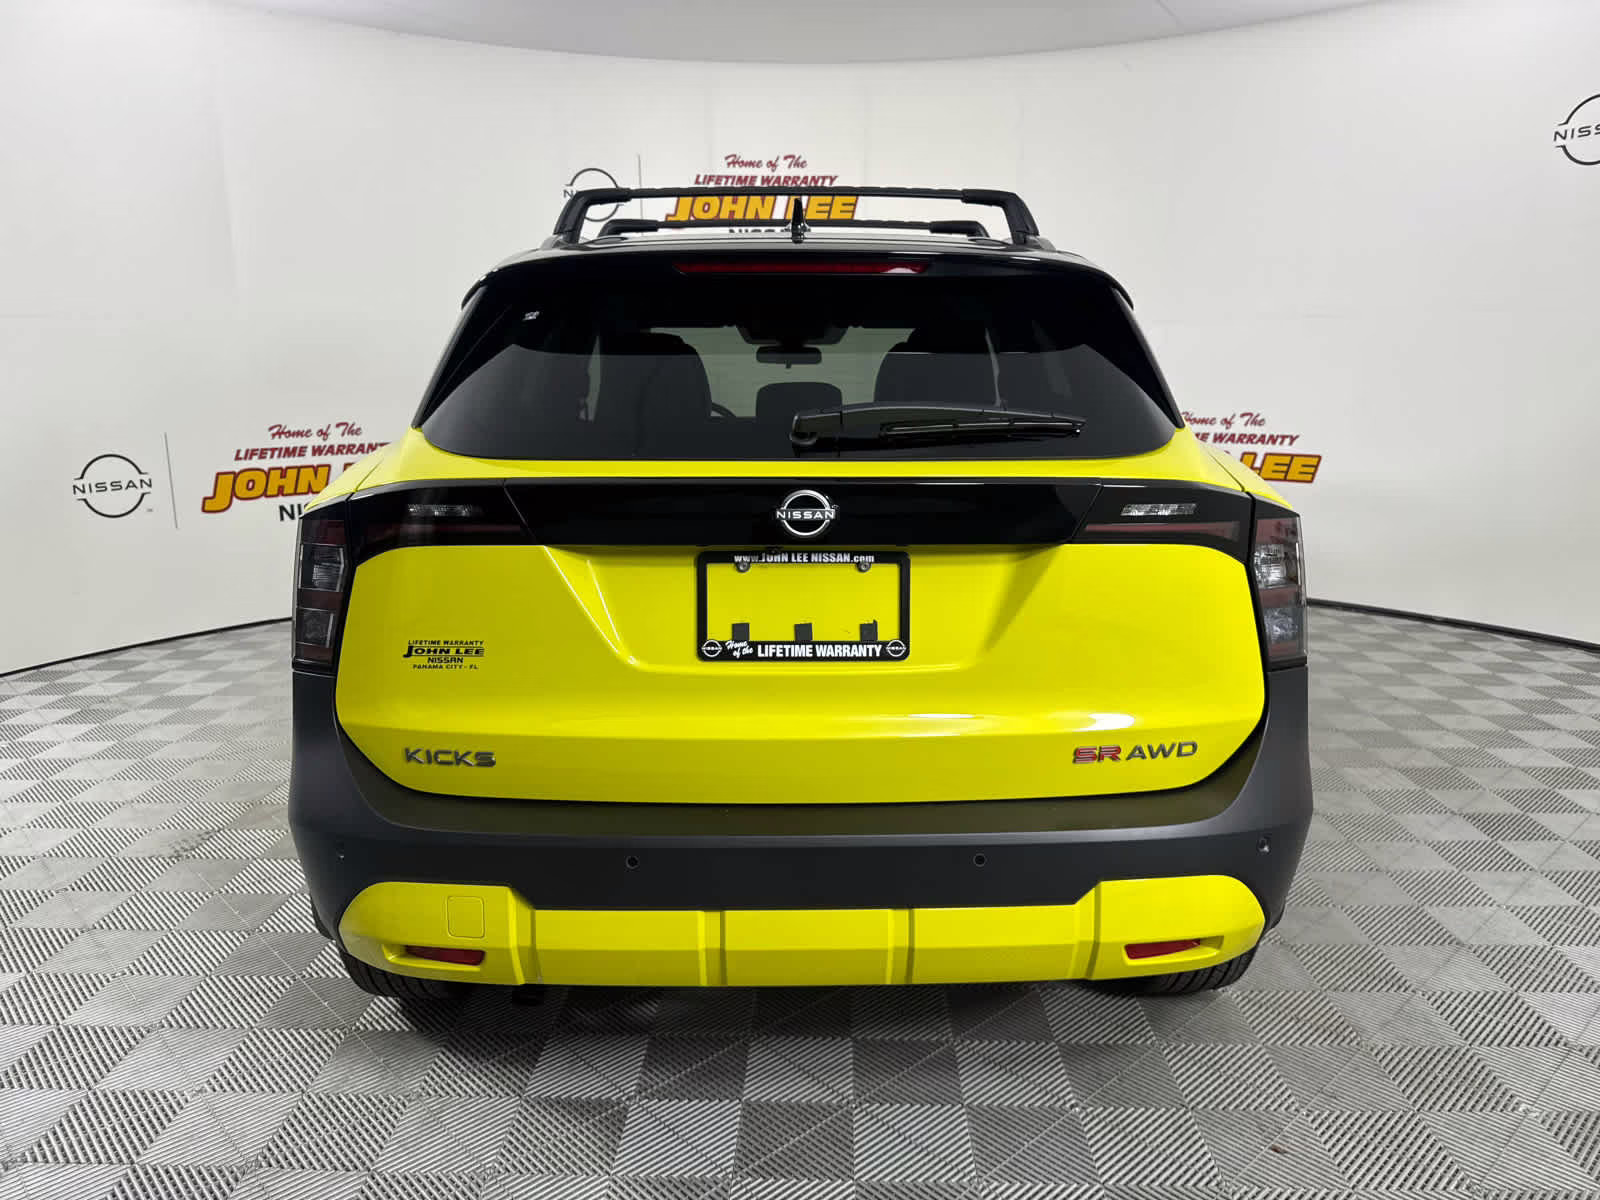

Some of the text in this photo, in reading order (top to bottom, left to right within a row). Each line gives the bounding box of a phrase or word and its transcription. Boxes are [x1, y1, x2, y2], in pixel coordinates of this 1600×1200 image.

[724, 153, 808, 172] Home of The
[694, 174, 838, 187] LIFETIME WARRANTY
[665, 195, 776, 221] JOHN
[1220, 413, 1236, 430] of
[1239, 412, 1266, 427] The
[268, 422, 362, 441] Home of The
[1212, 432, 1300, 446] WARRANTY
[234, 442, 391, 461] LIFETIME WARRAN
[72, 478, 152, 495] NISSAN
[201, 464, 331, 513] JOHN
[776, 510, 835, 519] NISSAN
[791, 552, 809, 563] LEE
[403, 645, 451, 658] JOHN
[725, 640, 748, 650] Home
[732, 647, 741, 659] of
[757, 644, 882, 657] LIFETIME WARRANTY
[405, 748, 496, 767] KICKS
[1073, 741, 1198, 764] SR AWD
